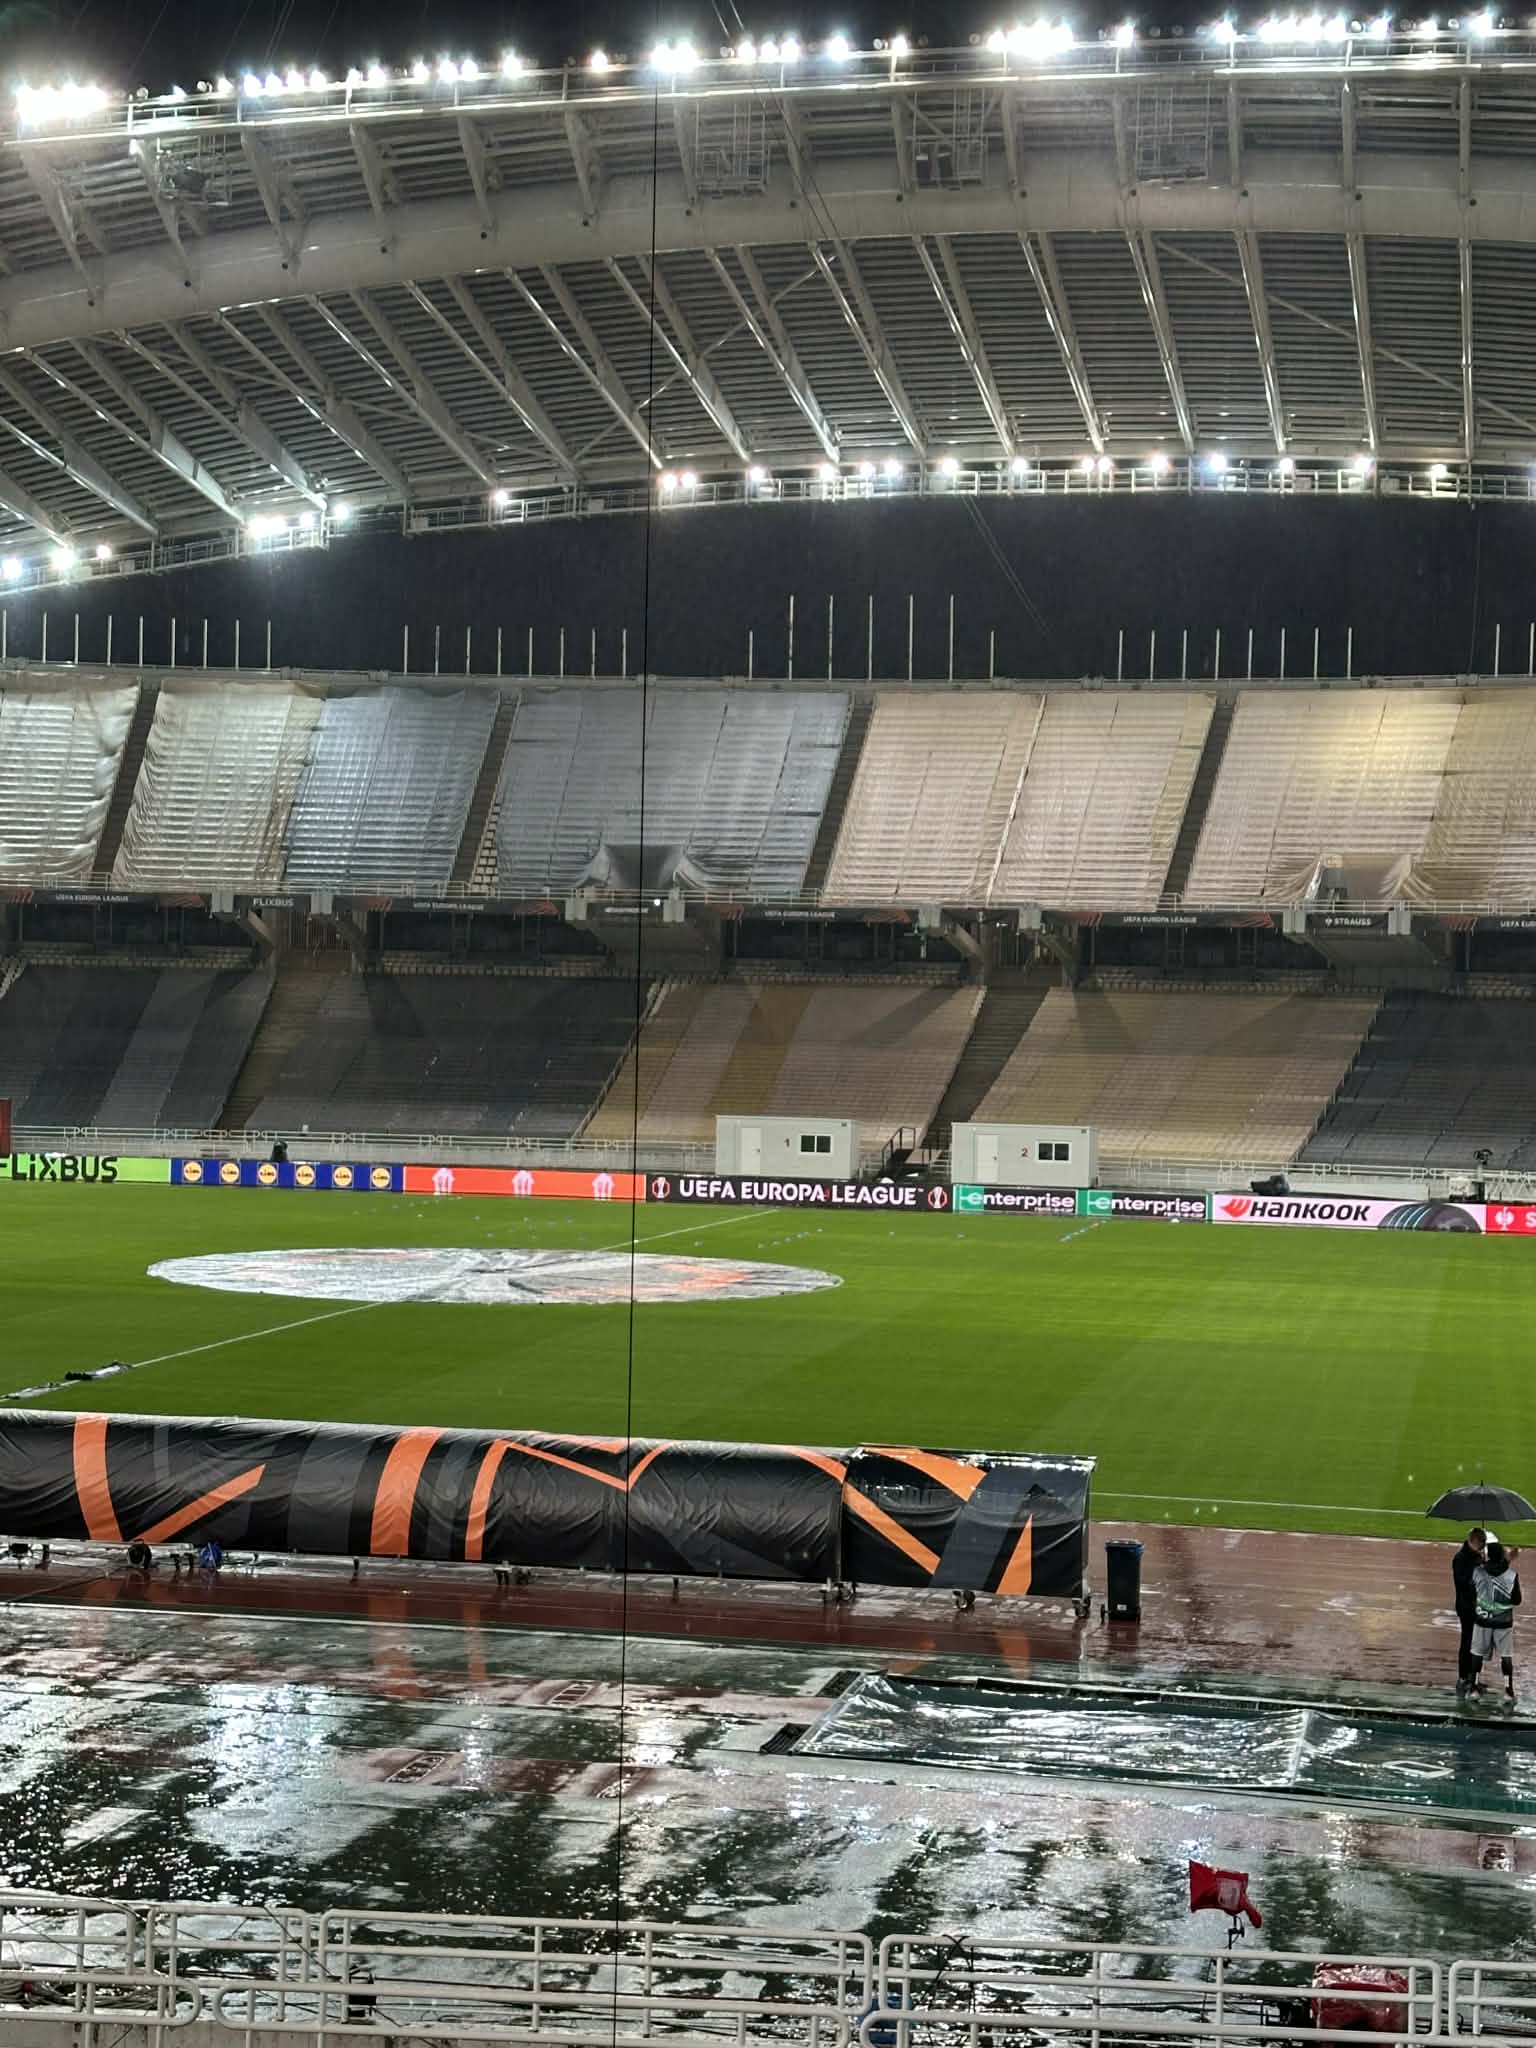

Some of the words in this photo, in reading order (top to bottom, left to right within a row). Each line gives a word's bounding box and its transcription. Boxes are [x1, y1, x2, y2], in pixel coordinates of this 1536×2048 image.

[1021, 1147, 1029, 1157] 2
[679, 1179, 736, 1199] UEFA
[741, 1181, 826, 1203] EUROPA
[831, 1185, 917, 1206] LEAGUE
[966, 1191, 1075, 1210] enterprise
[1095, 1196, 1205, 1215] enterprise
